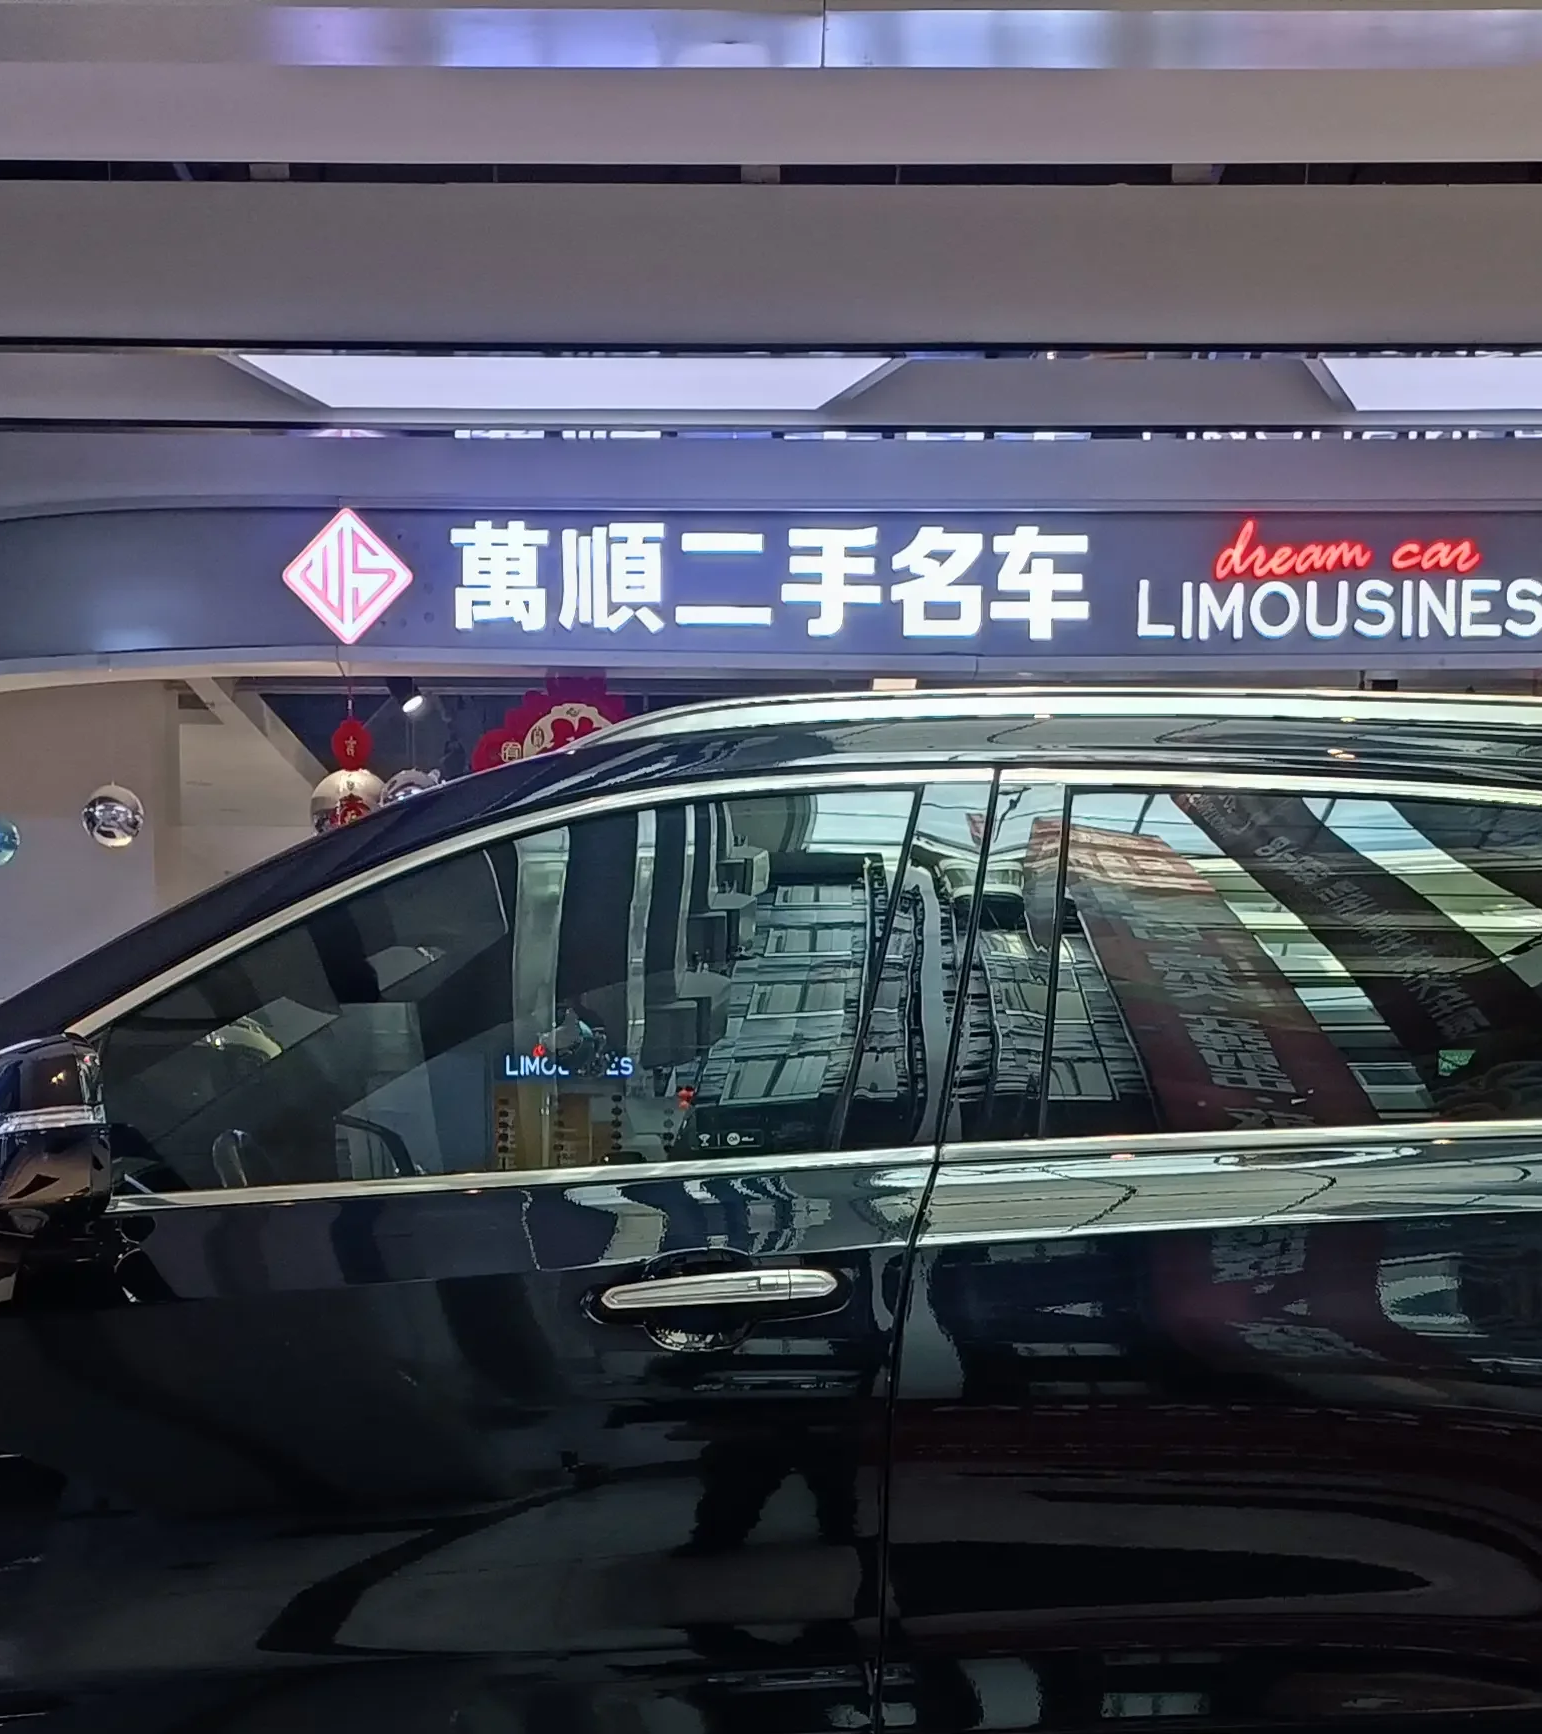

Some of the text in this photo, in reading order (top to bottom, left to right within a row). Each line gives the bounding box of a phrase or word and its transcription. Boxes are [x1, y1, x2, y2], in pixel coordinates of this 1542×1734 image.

[450, 519, 1091, 640] 萬順二手名车
[1214, 518, 1481, 580] dream car
